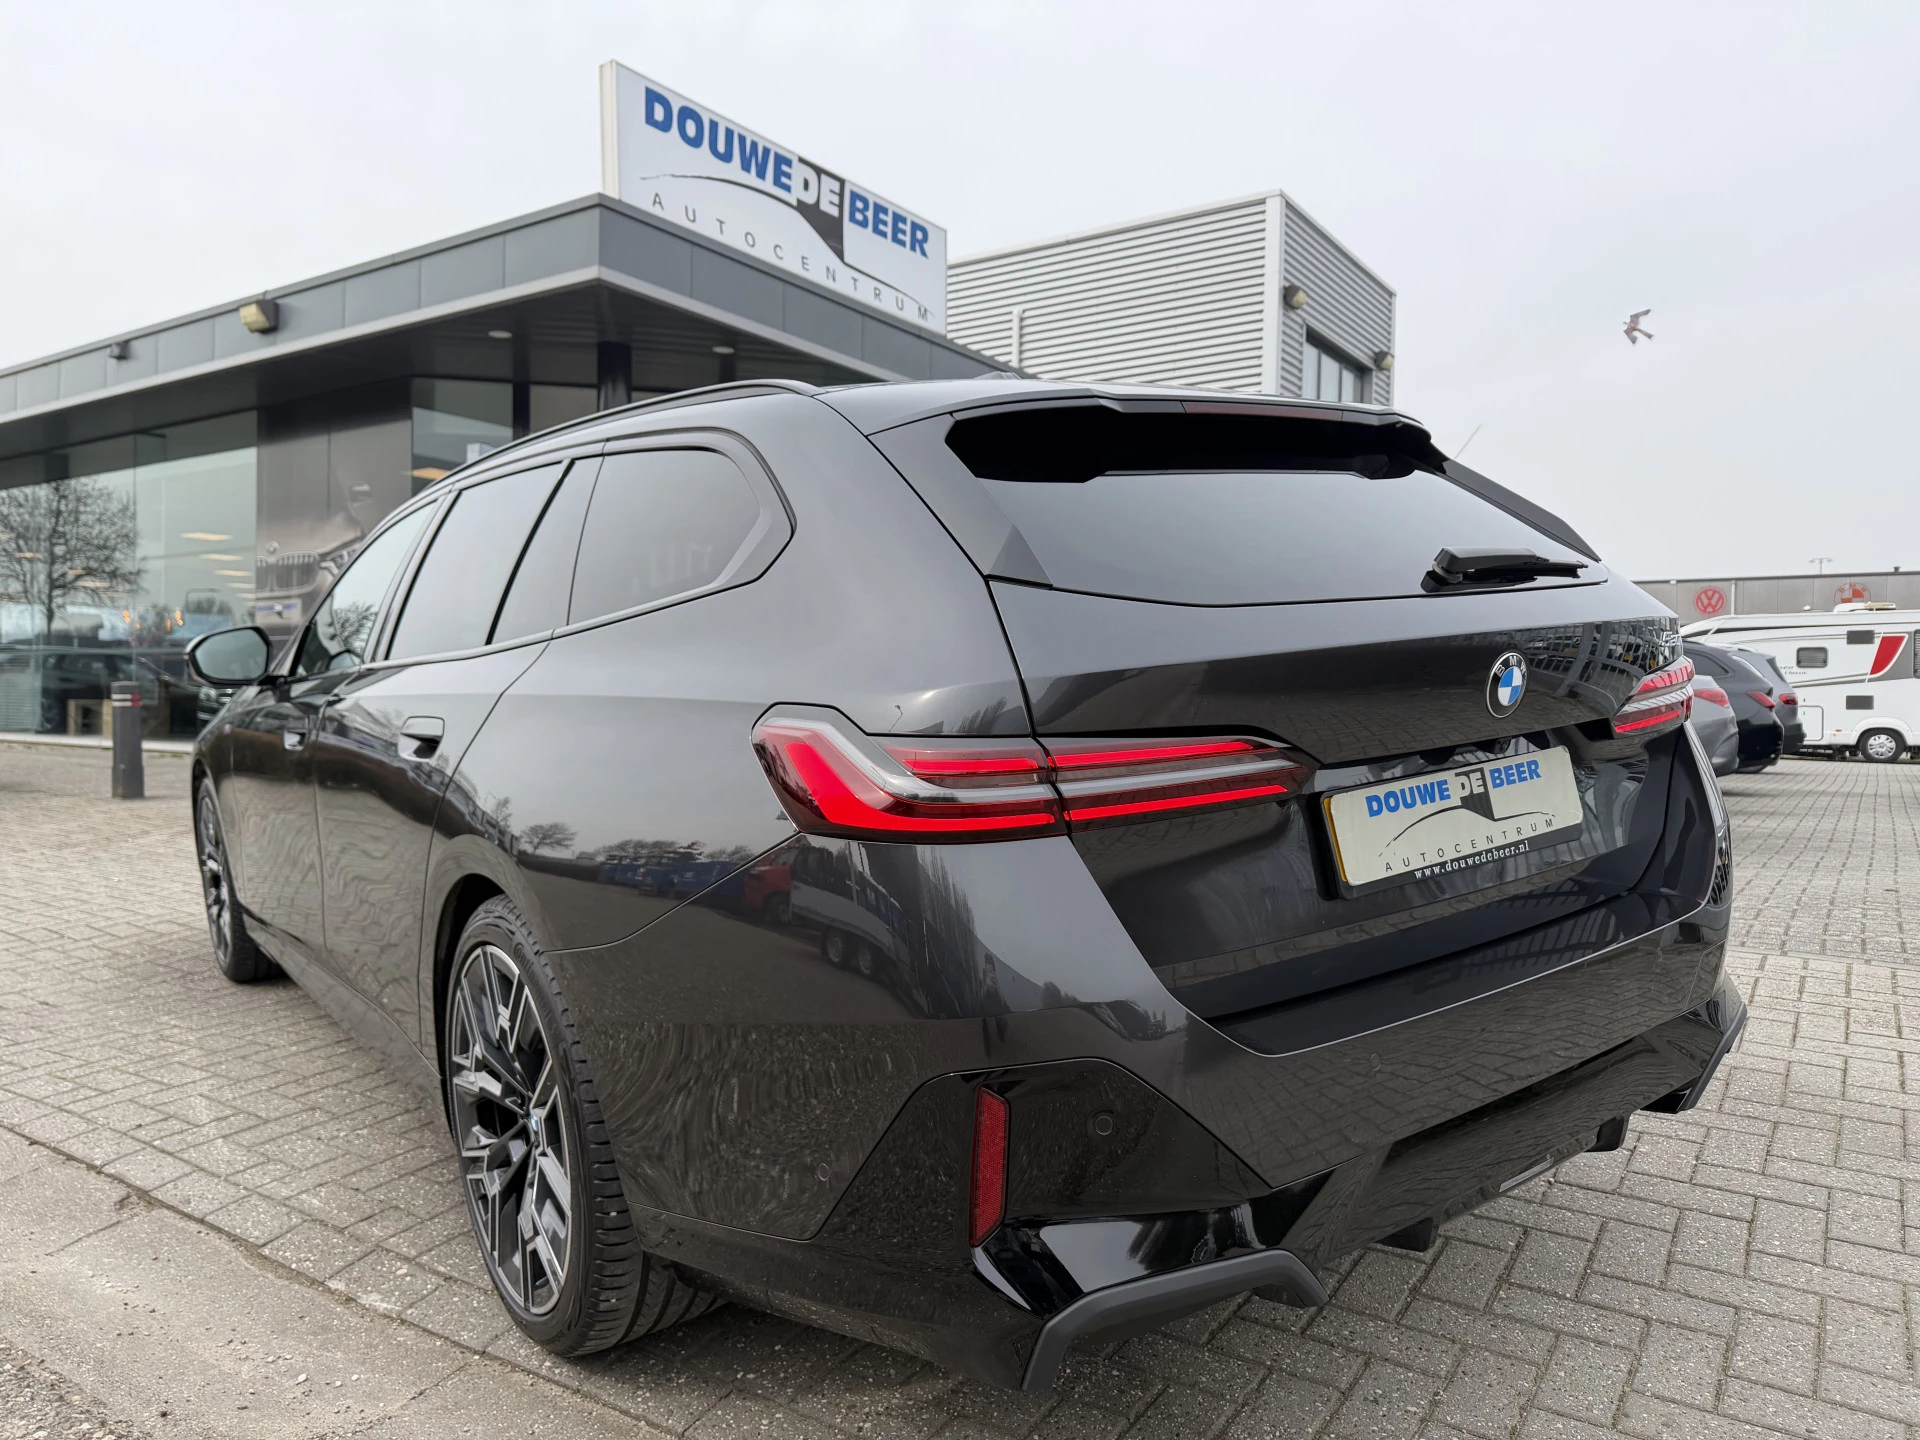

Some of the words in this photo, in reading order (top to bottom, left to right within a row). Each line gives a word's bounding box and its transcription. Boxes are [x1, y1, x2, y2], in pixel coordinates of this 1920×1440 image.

[645, 86, 793, 194] DOUWE
[799, 160, 841, 218] DE
[849, 189, 929, 259] BEER
[652, 192, 928, 322] AUTOCENTRUM
[1365, 779, 1452, 817] DOUWE
[1458, 772, 1485, 798] DE
[1489, 759, 1542, 789] BEER
[1385, 818, 1555, 873] AUTOCENTRUM
[1414, 840, 1530, 879] www.douwedebeer.nl
